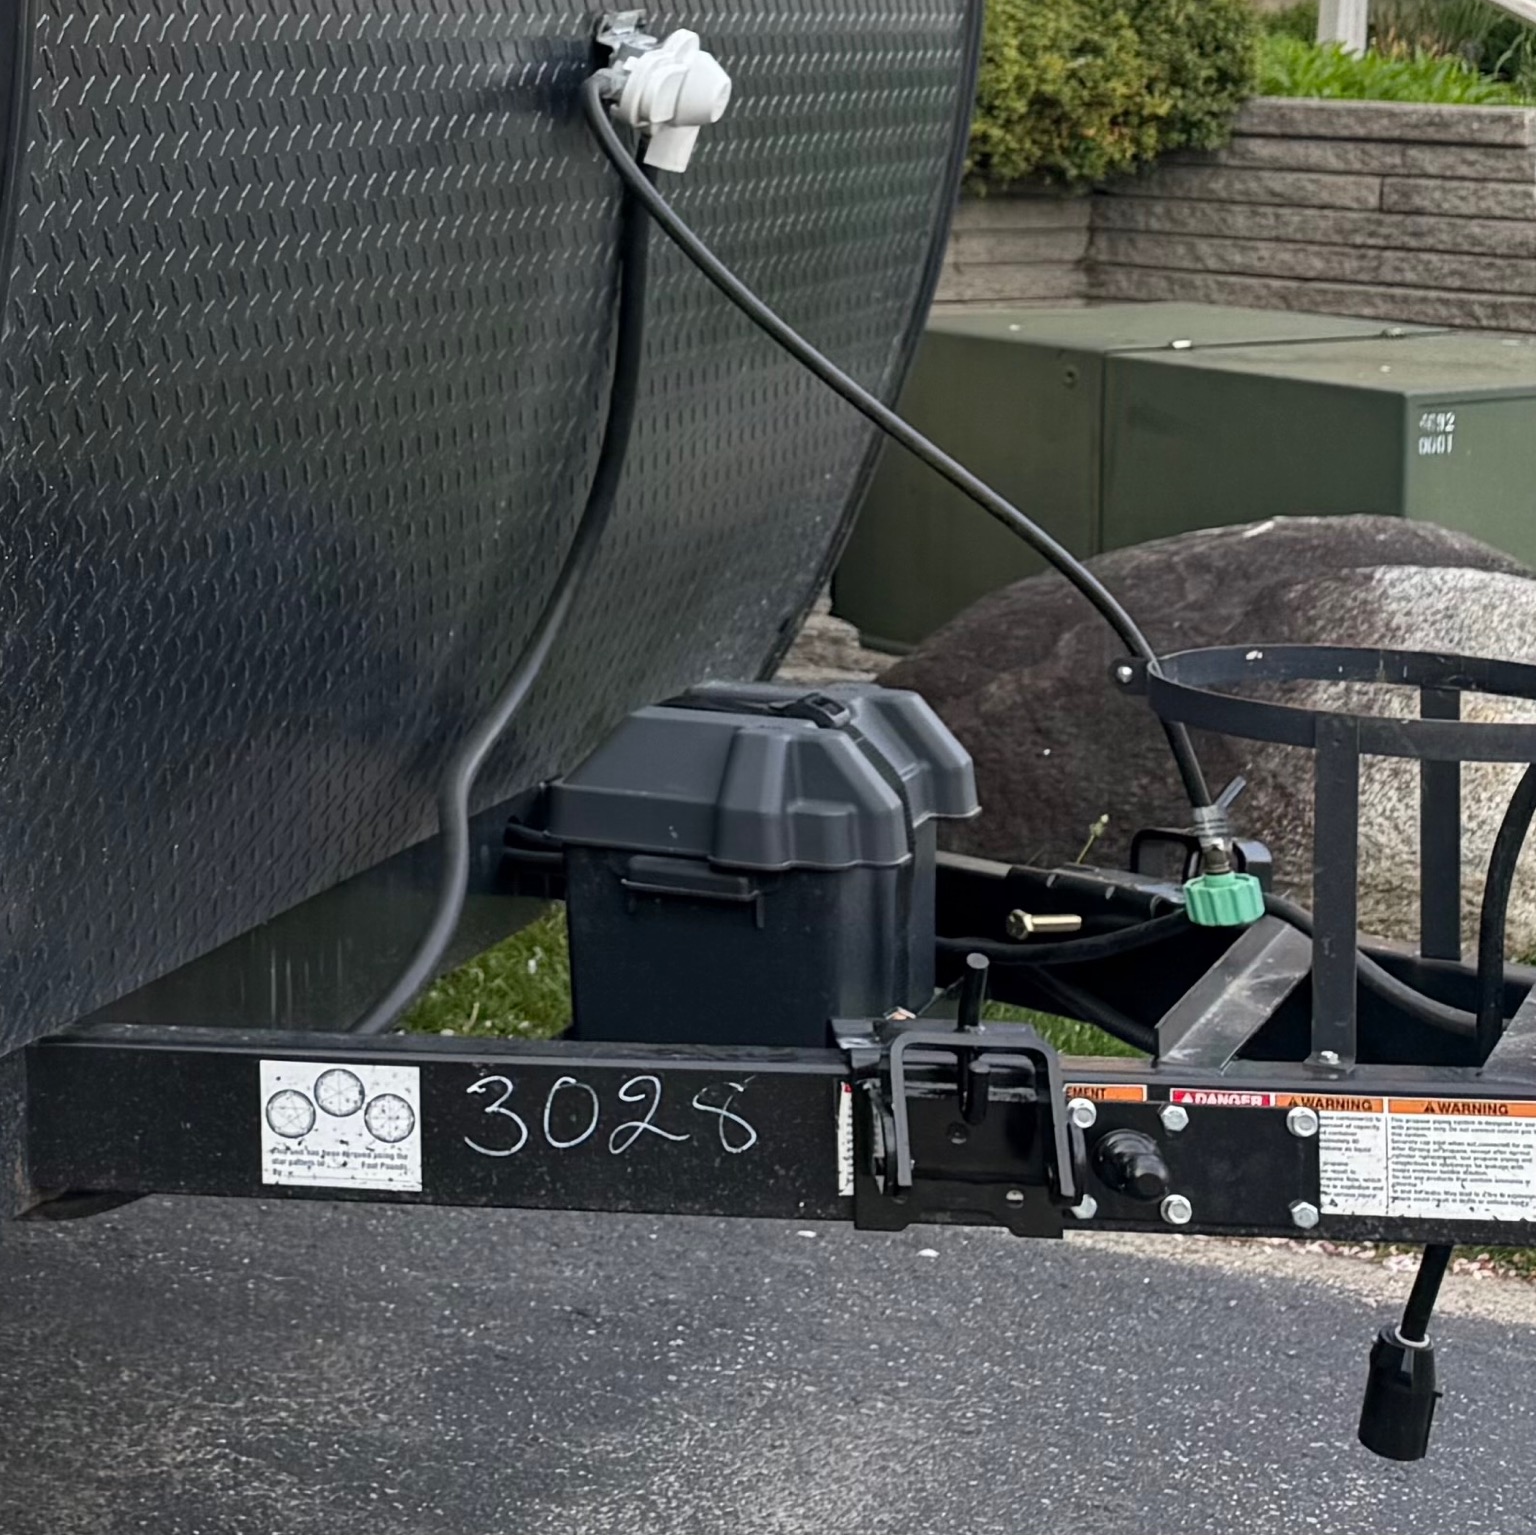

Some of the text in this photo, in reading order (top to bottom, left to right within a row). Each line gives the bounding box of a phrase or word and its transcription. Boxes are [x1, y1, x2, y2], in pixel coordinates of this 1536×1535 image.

[1194, 1091, 1263, 1106] DANGER
[1301, 1095, 1373, 1112] WARNING
[464, 1075, 758, 1156] 3028
[1436, 1100, 1509, 1115] WARNING
